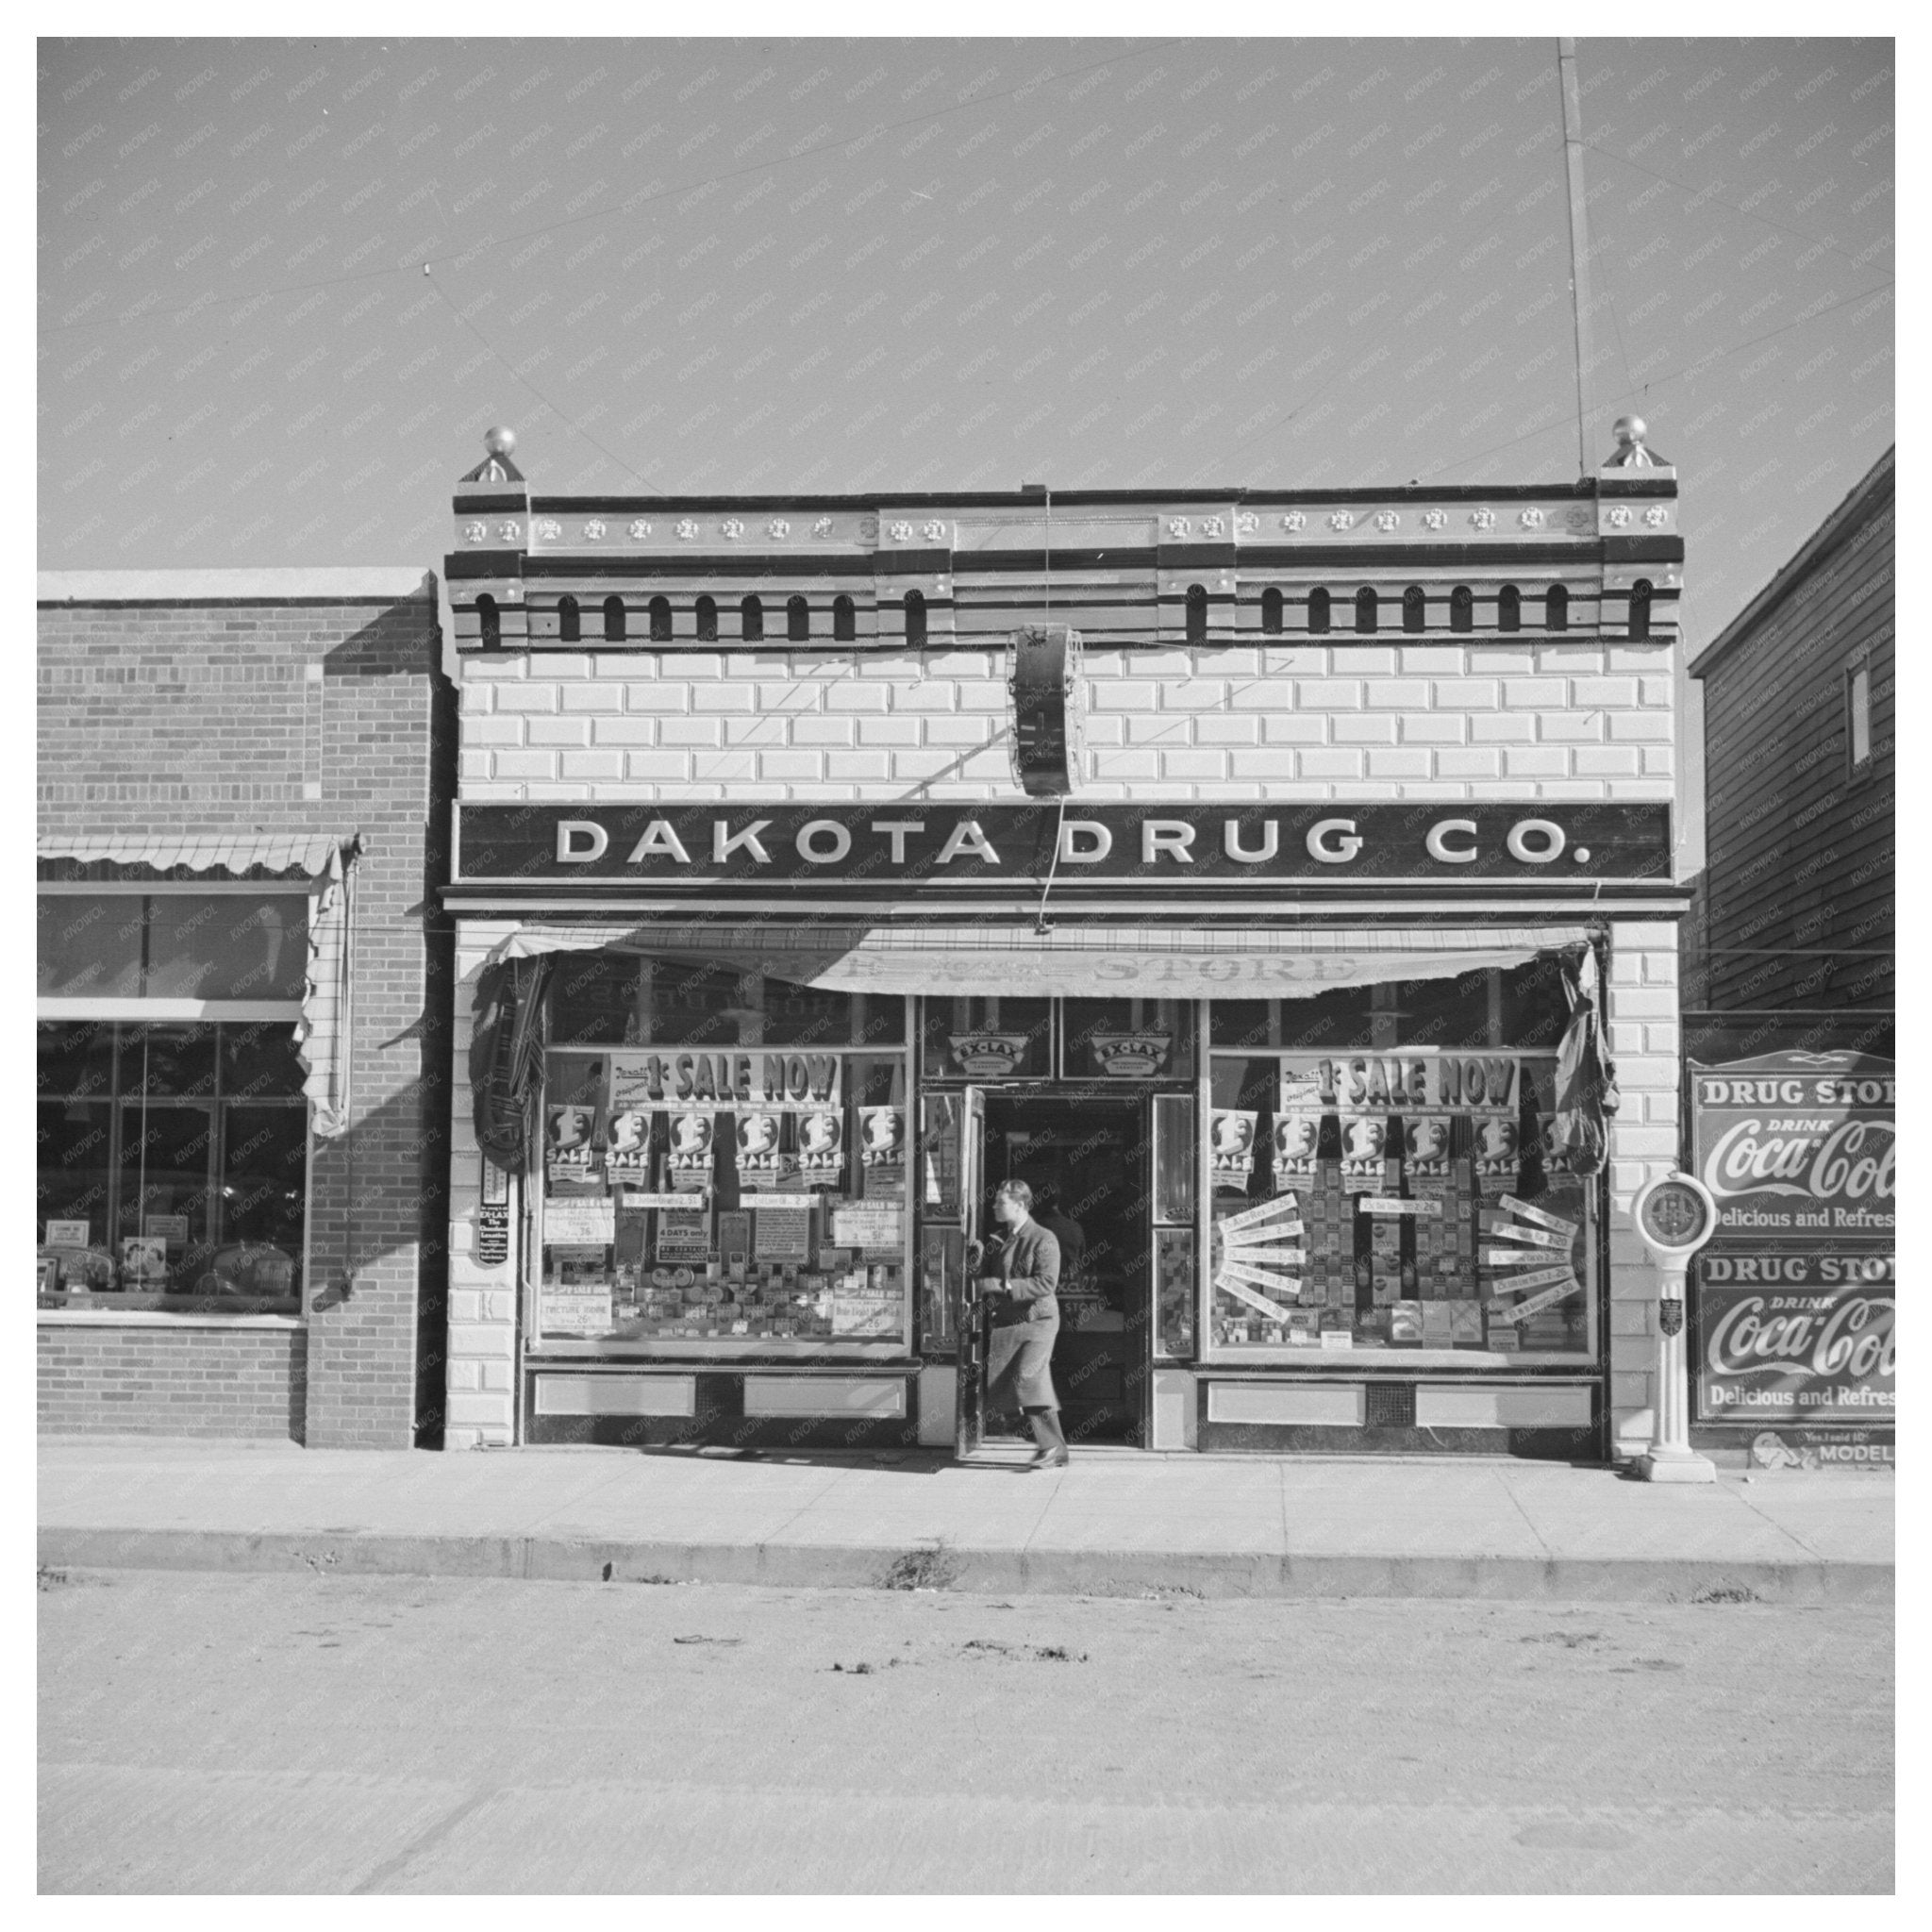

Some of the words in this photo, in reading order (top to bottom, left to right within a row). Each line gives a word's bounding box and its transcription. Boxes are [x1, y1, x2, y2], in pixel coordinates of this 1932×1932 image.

[556, 819, 1001, 864] DAKOTA
[1058, 818, 1363, 864] DRUG
[1424, 818, 1591, 864] CO.
[1094, 958, 1358, 982] STORE
[959, 1041, 1018, 1059] EX-LAX
[1101, 1042, 1160, 1060] EX-LAX
[675, 1054, 752, 1101] SALE
[762, 1054, 838, 1102] NOW
[1349, 1057, 1426, 1106] SALE
[1439, 1058, 1515, 1106] NOW
[1704, 1080, 1804, 1104] DRUG
[1766, 1119, 1835, 1131] DRINK
[546, 1148, 590, 1164] SALE
[605, 1152, 648, 1167] SALE
[668, 1153, 712, 1169] SALE
[735, 1153, 779, 1170] SALE
[798, 1153, 842, 1169] SALE
[861, 1150, 906, 1167] SALE
[1209, 1154, 1252, 1171] SALE
[1272, 1158, 1318, 1174] SALE
[1340, 1159, 1386, 1176] SALE
[1404, 1160, 1450, 1176] SALE
[1475, 1159, 1522, 1176] SALE
[867, 1201, 885, 1209] SALE
[1713, 1208, 1790, 1227] elicious
[1795, 1208, 1830, 1227] and
[690, 1229, 708, 1238] only
[1707, 1257, 1807, 1281] DRUG
[1057, 1275, 1100, 1293] xall
[1064, 1302, 1105, 1312] STORE
[1770, 1296, 1838, 1309] DRINK
[1710, 1385, 1794, 1406] Delicious
[1798, 1385, 1833, 1406] and
[1819, 1444, 1894, 1461] MODEL
